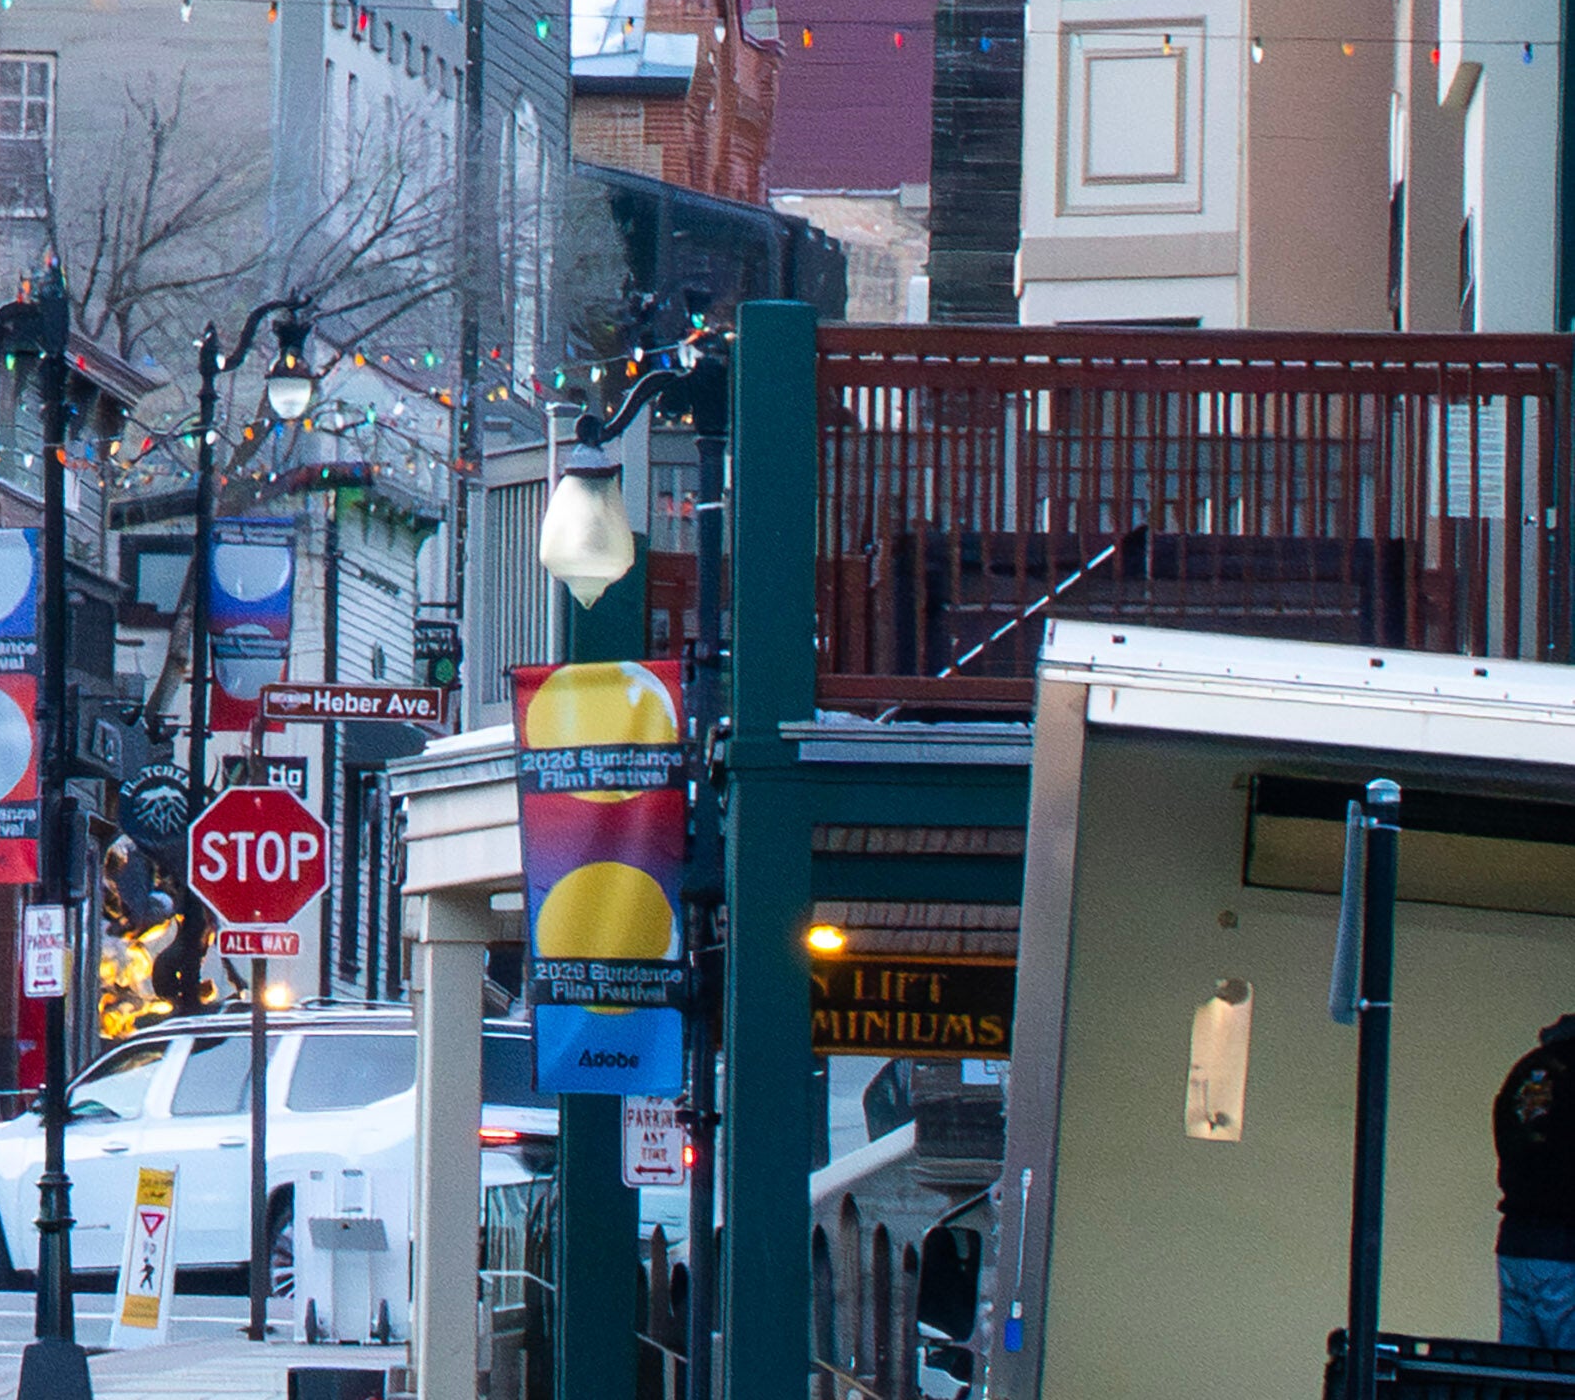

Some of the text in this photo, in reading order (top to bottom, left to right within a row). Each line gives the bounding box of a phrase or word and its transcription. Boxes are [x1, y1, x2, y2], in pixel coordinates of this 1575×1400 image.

[313, 690, 437, 716] Heber Ave.
[522, 749, 683, 771] 2026 Sundance
[539, 766, 668, 791] Film Festival
[199, 831, 319, 883] STOP
[225, 935, 294, 953] ALL WAY
[854, 969, 948, 1004] LIFT
[578, 1049, 640, 1069] Adobe
[628, 1109, 680, 1129] PARKIN
